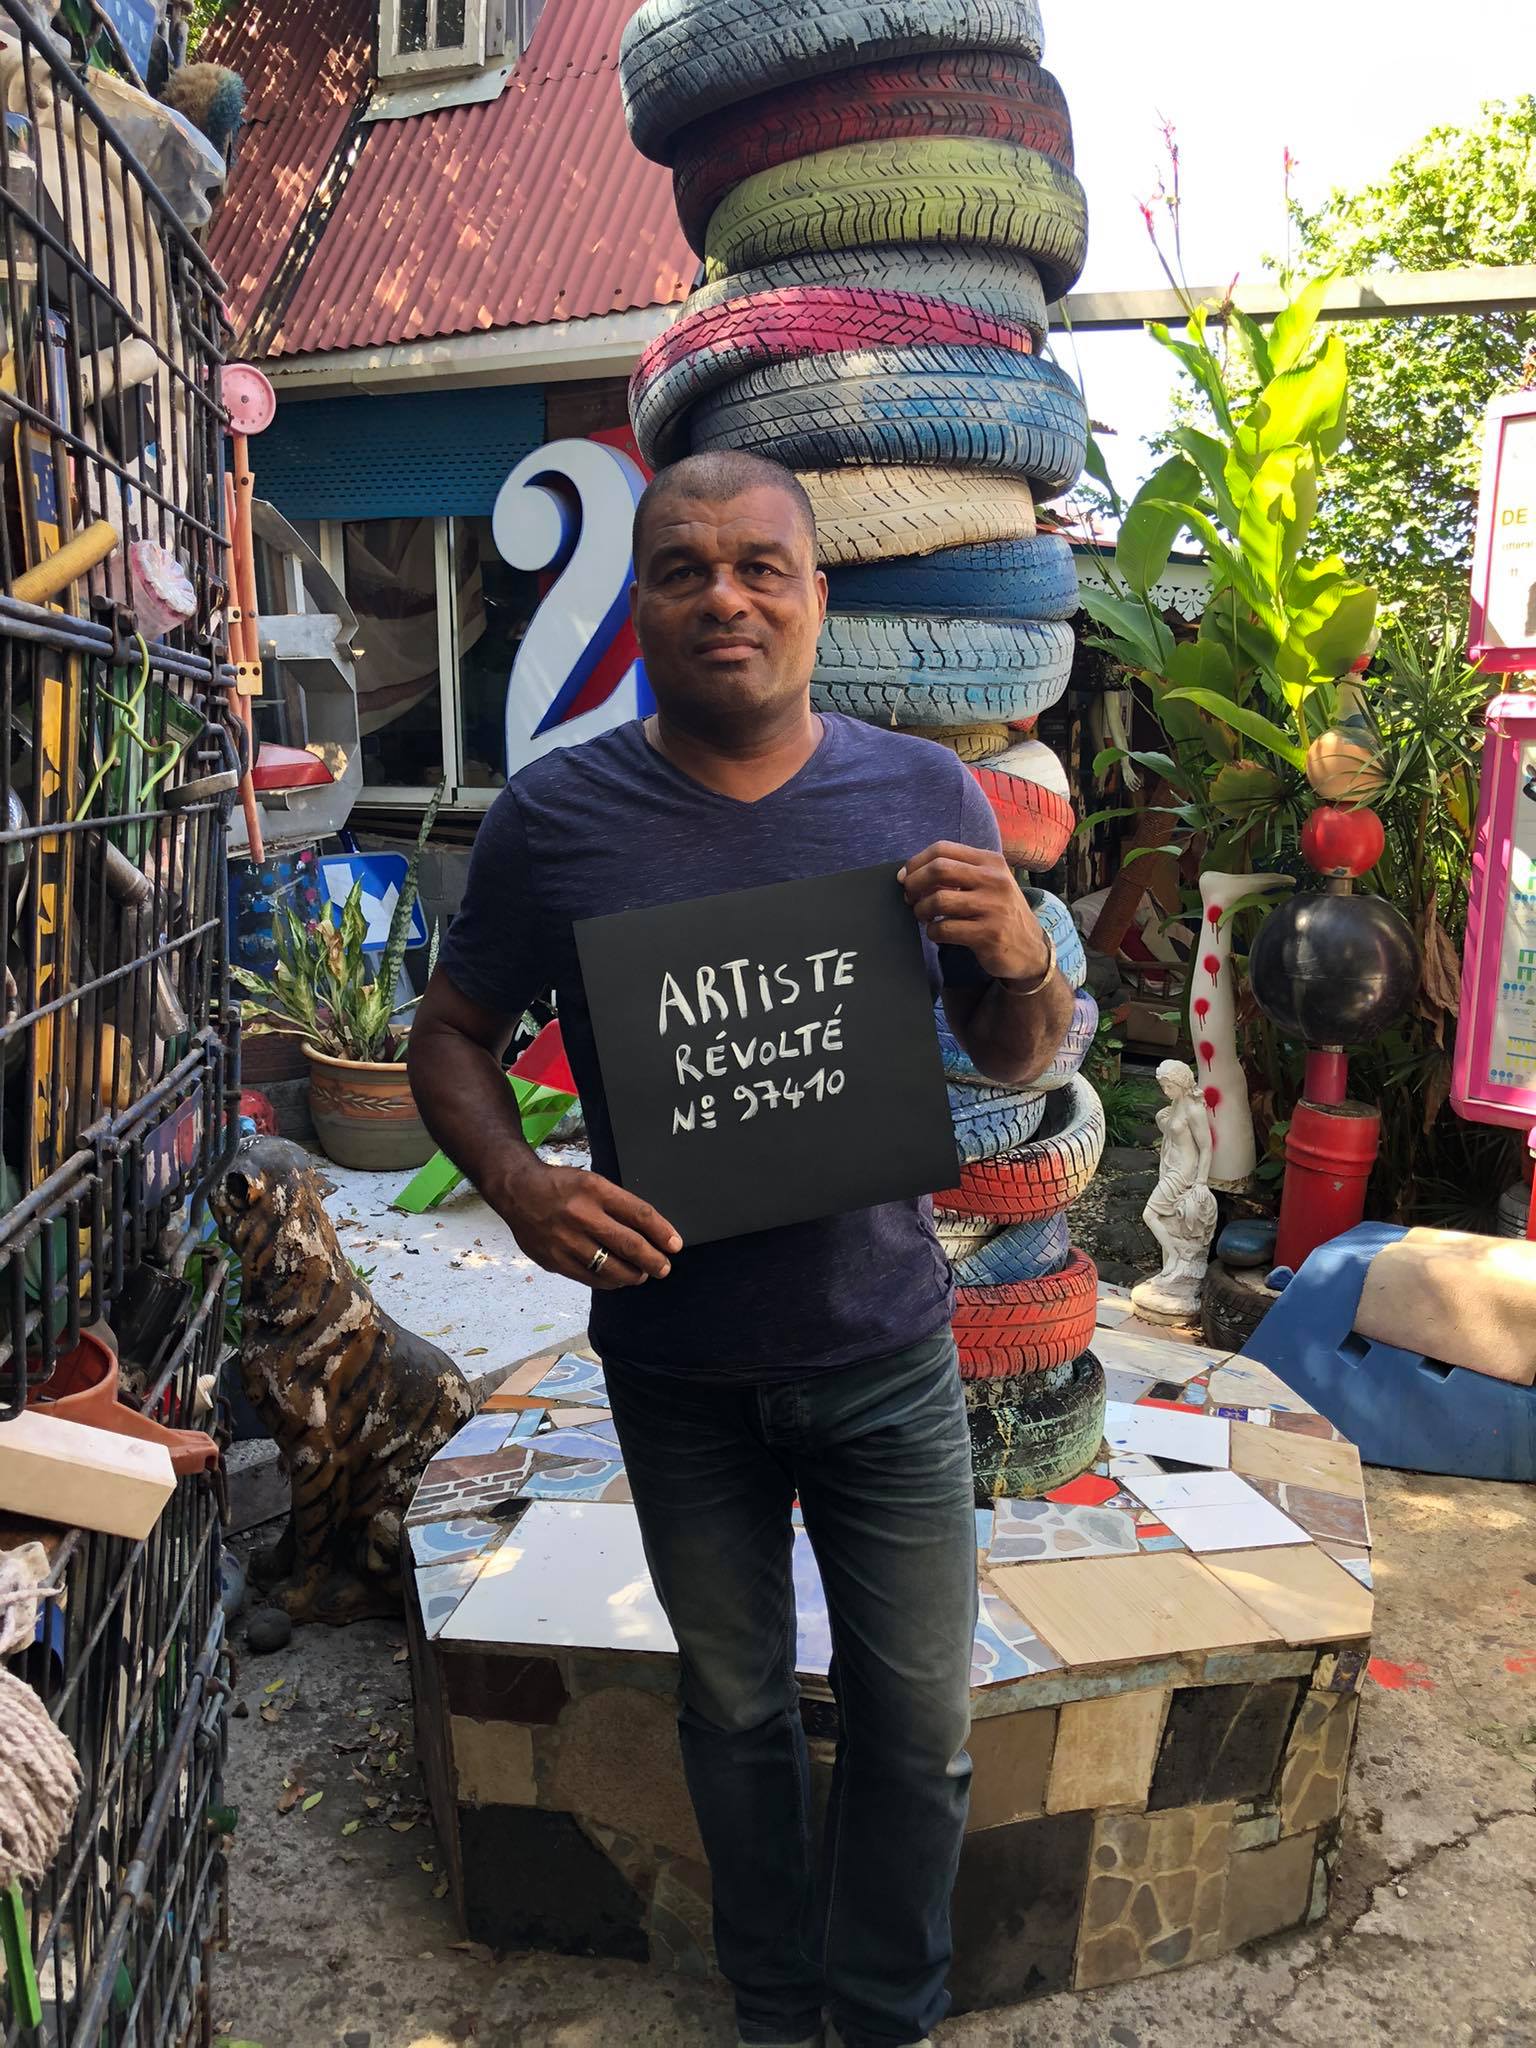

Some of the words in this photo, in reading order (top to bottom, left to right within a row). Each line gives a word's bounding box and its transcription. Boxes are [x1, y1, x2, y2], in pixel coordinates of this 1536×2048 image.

[1501, 508, 1528, 526] DE
[676, 1003, 844, 1085] RÉVOLTÉ
[733, 1067, 845, 1122] 97410
